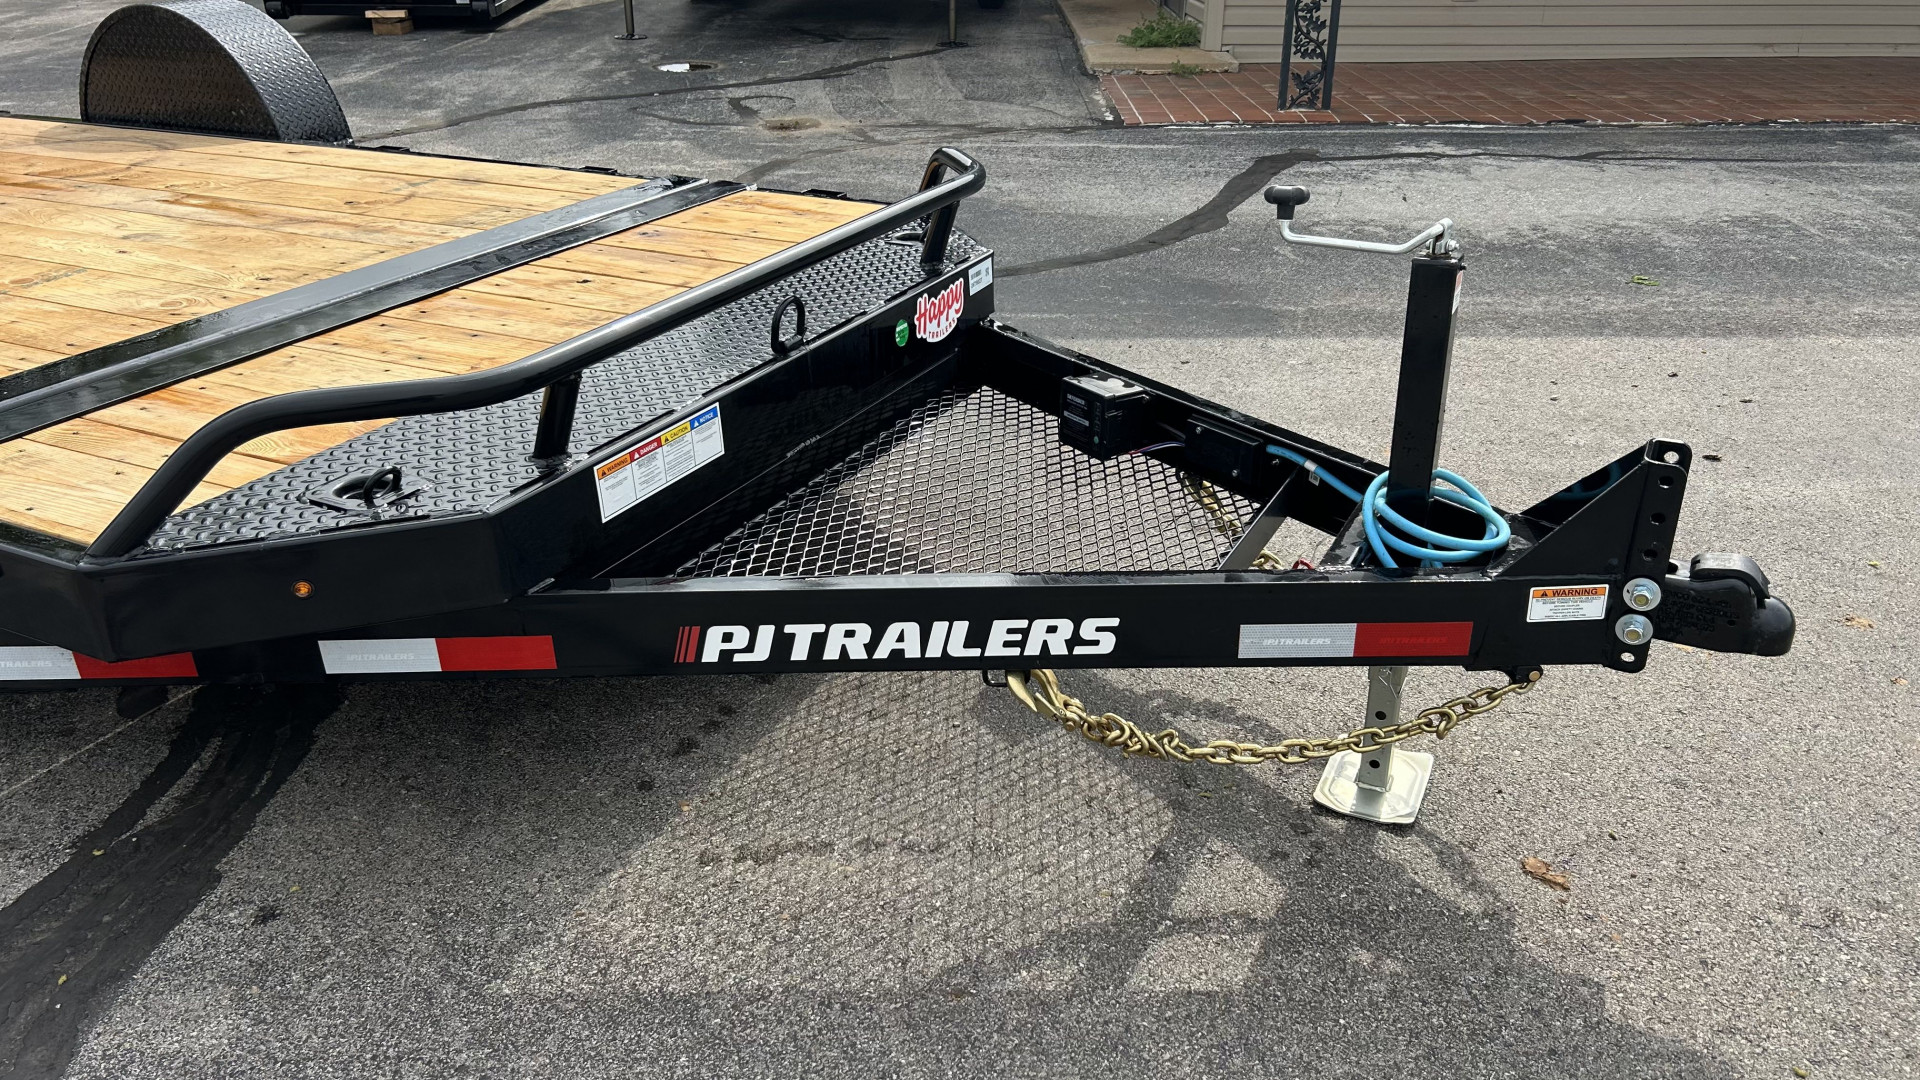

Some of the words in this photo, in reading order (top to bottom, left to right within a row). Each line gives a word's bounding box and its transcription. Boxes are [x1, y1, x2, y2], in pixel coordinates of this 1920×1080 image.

[916, 280, 963, 336] Happy
[928, 318, 956, 339] TRAILERS
[699, 412, 714, 423] NOTICE
[669, 425, 688, 439] CAUTION
[639, 442, 658, 455] DANGER
[607, 457, 629, 472] WARNING
[1552, 588, 1598, 597] WARNING
[701, 624, 776, 663] PJ
[783, 617, 1120, 660] TRAILERS
[363, 653, 415, 661] TRAILERS
[0, 660, 52, 668] TRAILERS
